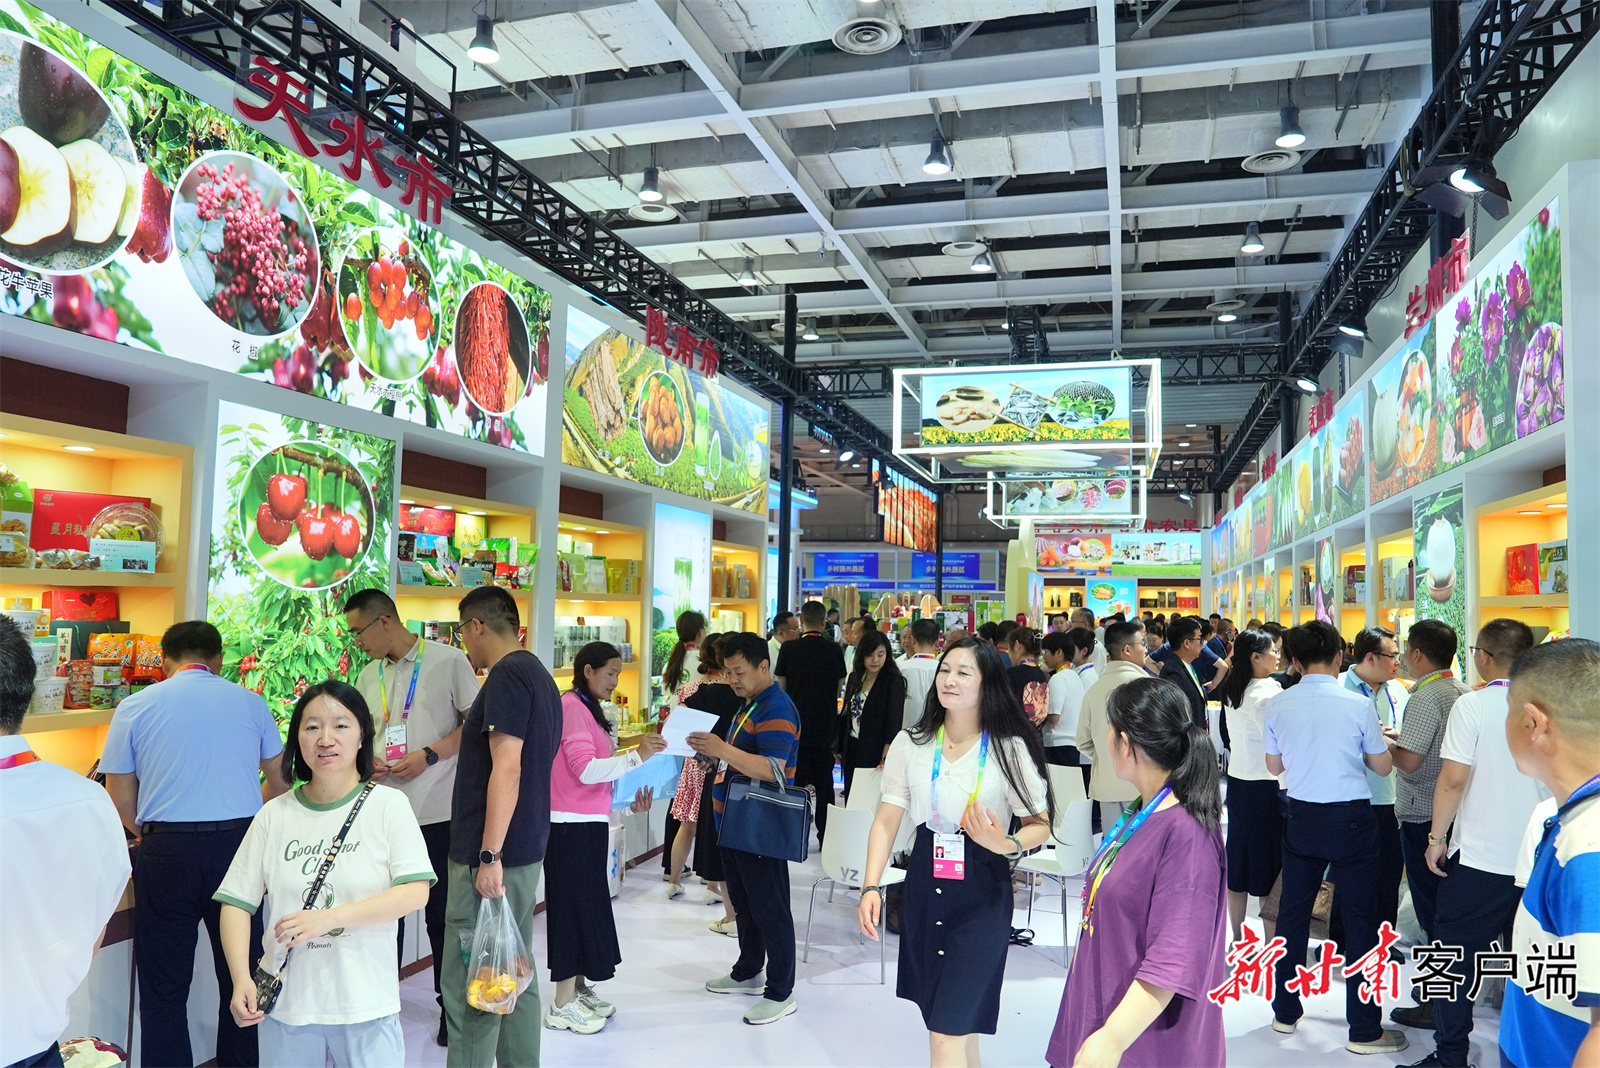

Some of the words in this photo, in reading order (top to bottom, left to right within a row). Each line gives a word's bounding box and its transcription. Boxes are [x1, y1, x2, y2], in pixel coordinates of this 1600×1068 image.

[234, 55, 454, 225] 天水市
[0, 268, 53, 299] 花牛苹果
[1404, 237, 1469, 339] 兰州市
[646, 304, 720, 379] 陇南市
[284, 839, 324, 861] Good
[302, 857, 335, 875] Clb
[306, 941, 332, 950] Peanuts
